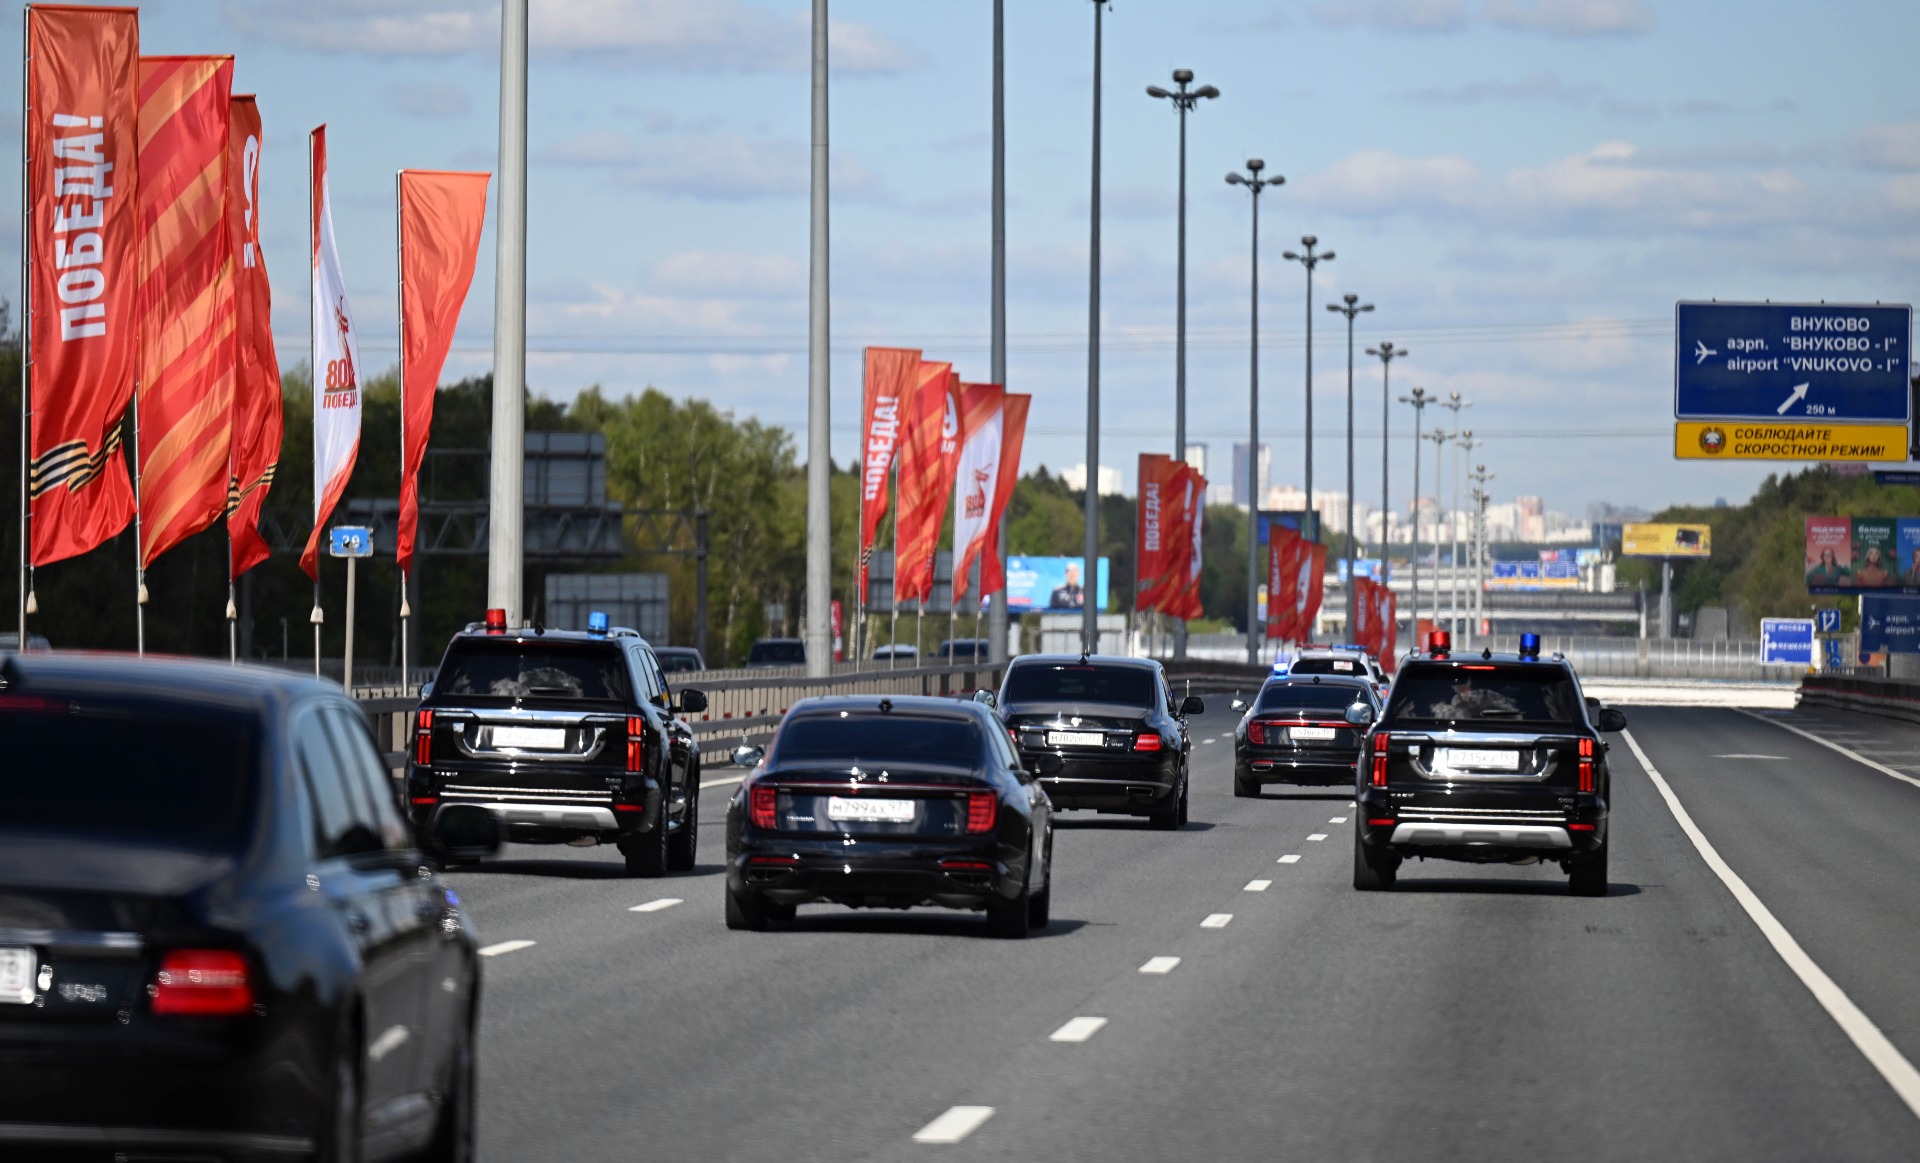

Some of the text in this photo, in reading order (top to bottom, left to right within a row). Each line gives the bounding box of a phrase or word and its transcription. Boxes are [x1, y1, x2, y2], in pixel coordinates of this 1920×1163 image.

[53, 113, 113, 342] ПОБЕДА!
[1790, 316, 1870, 332] ВНУКОВО
[1727, 337, 1769, 353] аэрп.
[1727, 356, 1779, 374] airport
[325, 358, 348, 389] 80
[1806, 404, 1825, 415] 250
[1734, 427, 1833, 442] СОБЛЮДАЙТЕ
[865, 396, 900, 501] ПОБЕДА!
[1734, 443, 1886, 457] СКОРОСТНОЙ РЕЖИМ!
